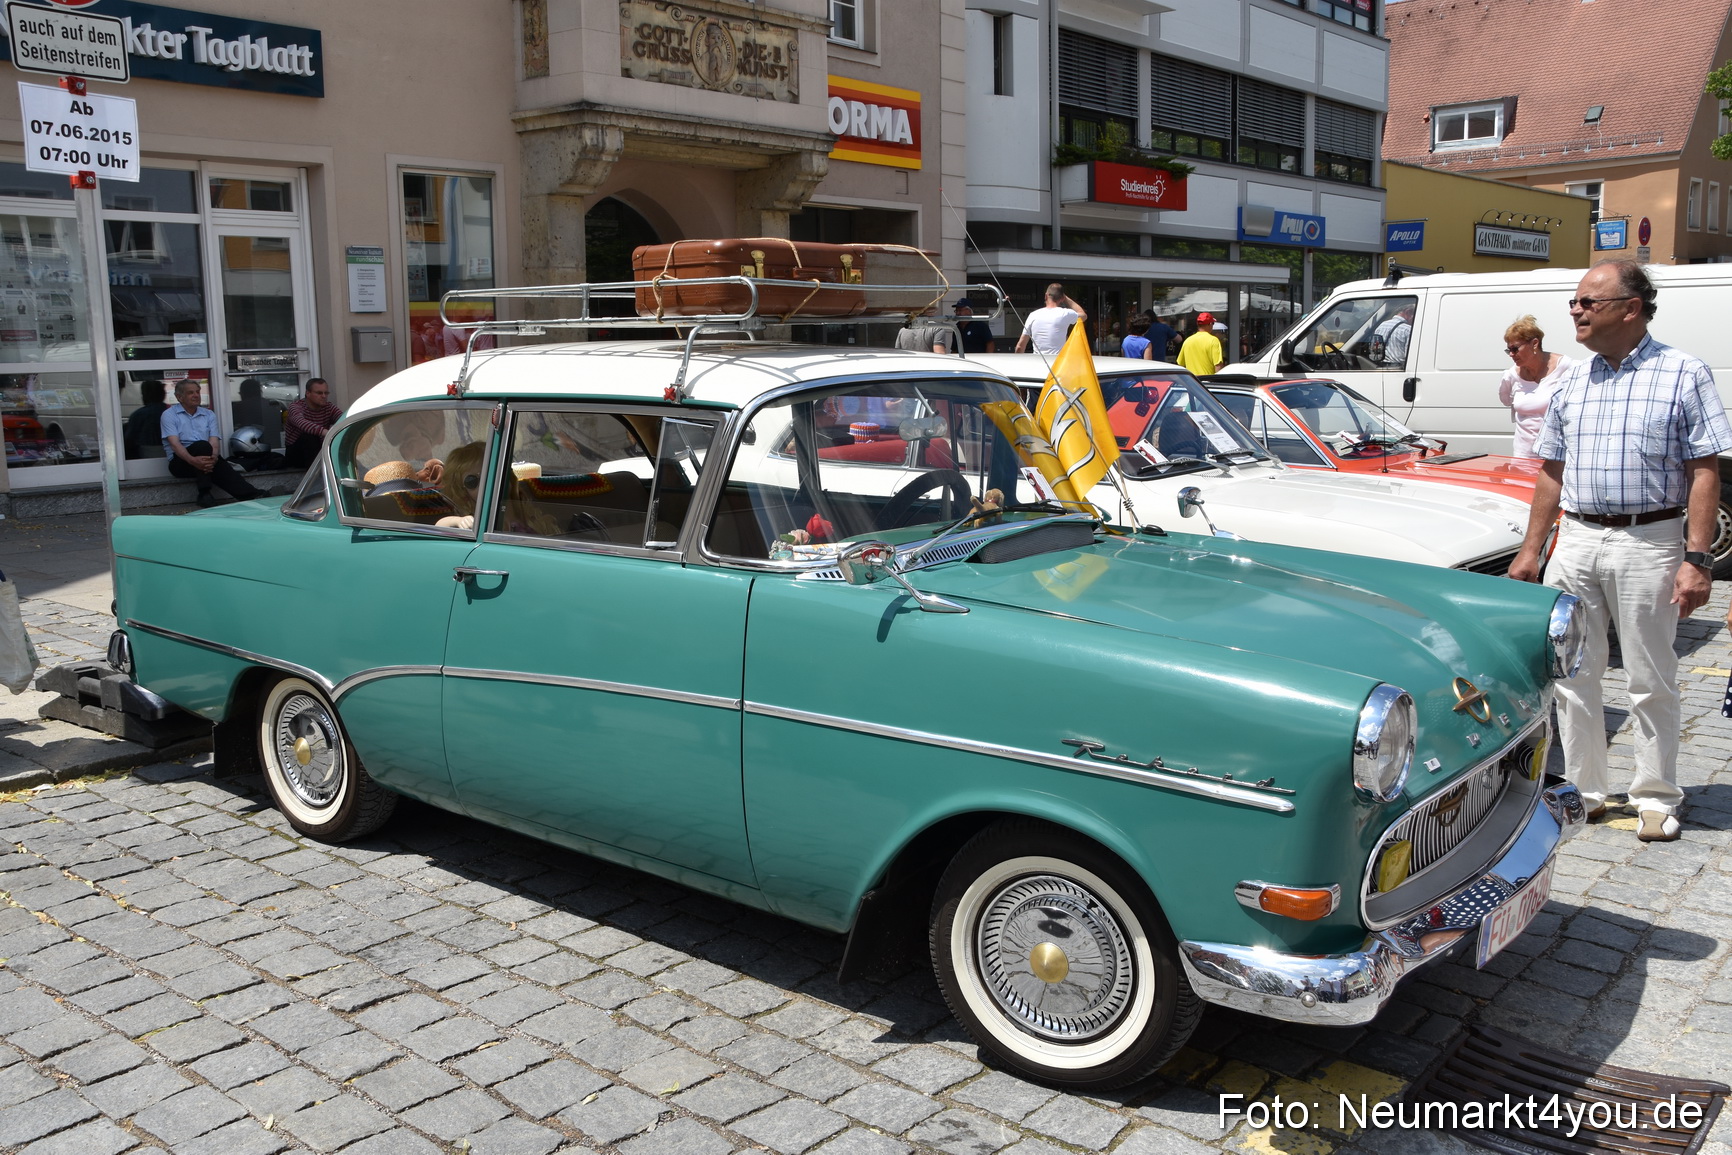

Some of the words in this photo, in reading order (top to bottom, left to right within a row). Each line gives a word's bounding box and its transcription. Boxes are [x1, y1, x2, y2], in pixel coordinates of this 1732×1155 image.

[20, 19, 55, 37] auch
[61, 25, 83, 41] auf
[88, 26, 117, 46] dem
[20, 40, 121, 70] Seitenstreifen
[122, 16, 187, 60] kter
[185, 25, 316, 77] Tagblatt
[70, 101, 94, 116] Ab
[829, 96, 913, 144] ORMA
[31, 120, 132, 145] 07.06.2015
[40, 146, 91, 165] 07:00
[97, 153, 128, 169] Uhr
[1121, 178, 1159, 194] Studienkreis
[1389, 230, 1420, 241] APOLLO
[1478, 231, 1511, 250] GASTHAUS
[1532, 237, 1548, 253] GANS
